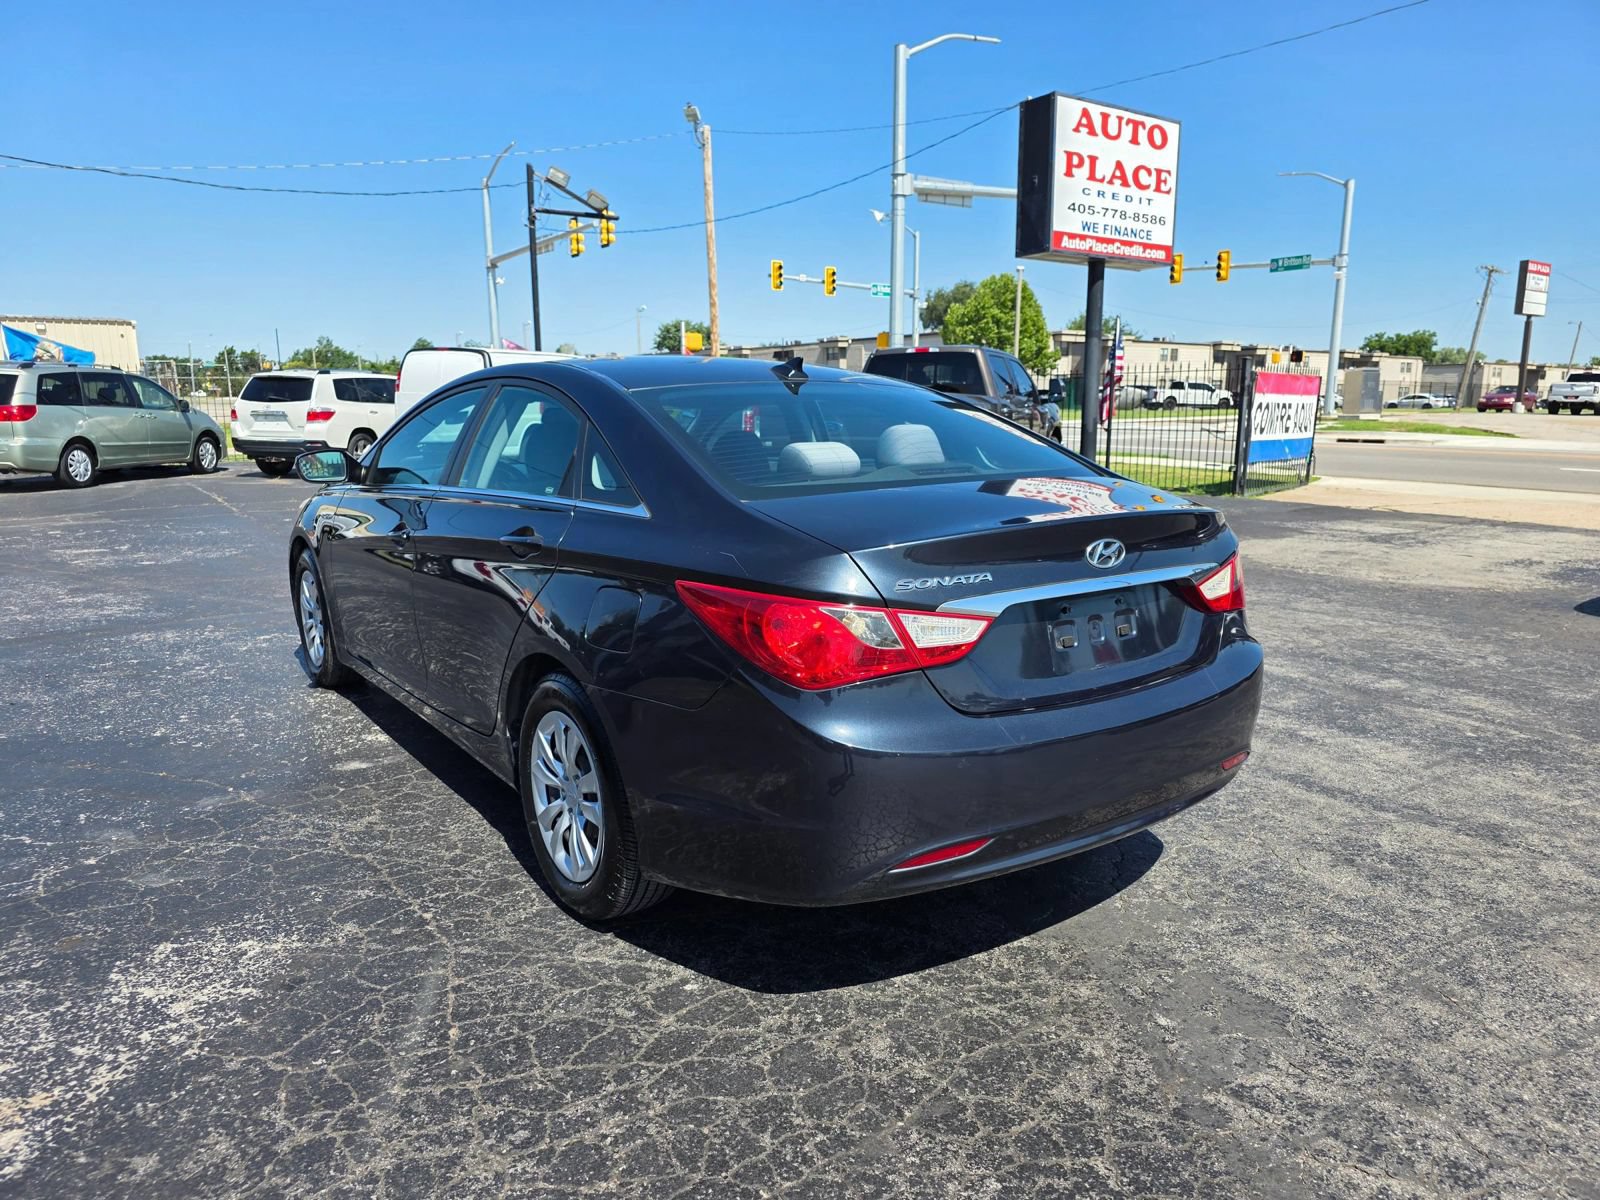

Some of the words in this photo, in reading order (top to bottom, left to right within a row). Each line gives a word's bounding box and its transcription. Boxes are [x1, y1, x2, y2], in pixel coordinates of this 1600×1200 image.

[1072, 107, 1168, 150] AUTO
[1063, 150, 1172, 195] PLACE
[1082, 187, 1154, 206] CREDIT
[1067, 202, 1166, 226] 405-778-8586
[1082, 220, 1099, 233] WE
[1104, 224, 1153, 241] FINANCE
[1061, 235, 1166, 259] AutoPlaceCredit.com
[1254, 401, 1292, 435] COMPRE
[895, 572, 993, 592] SONATA
